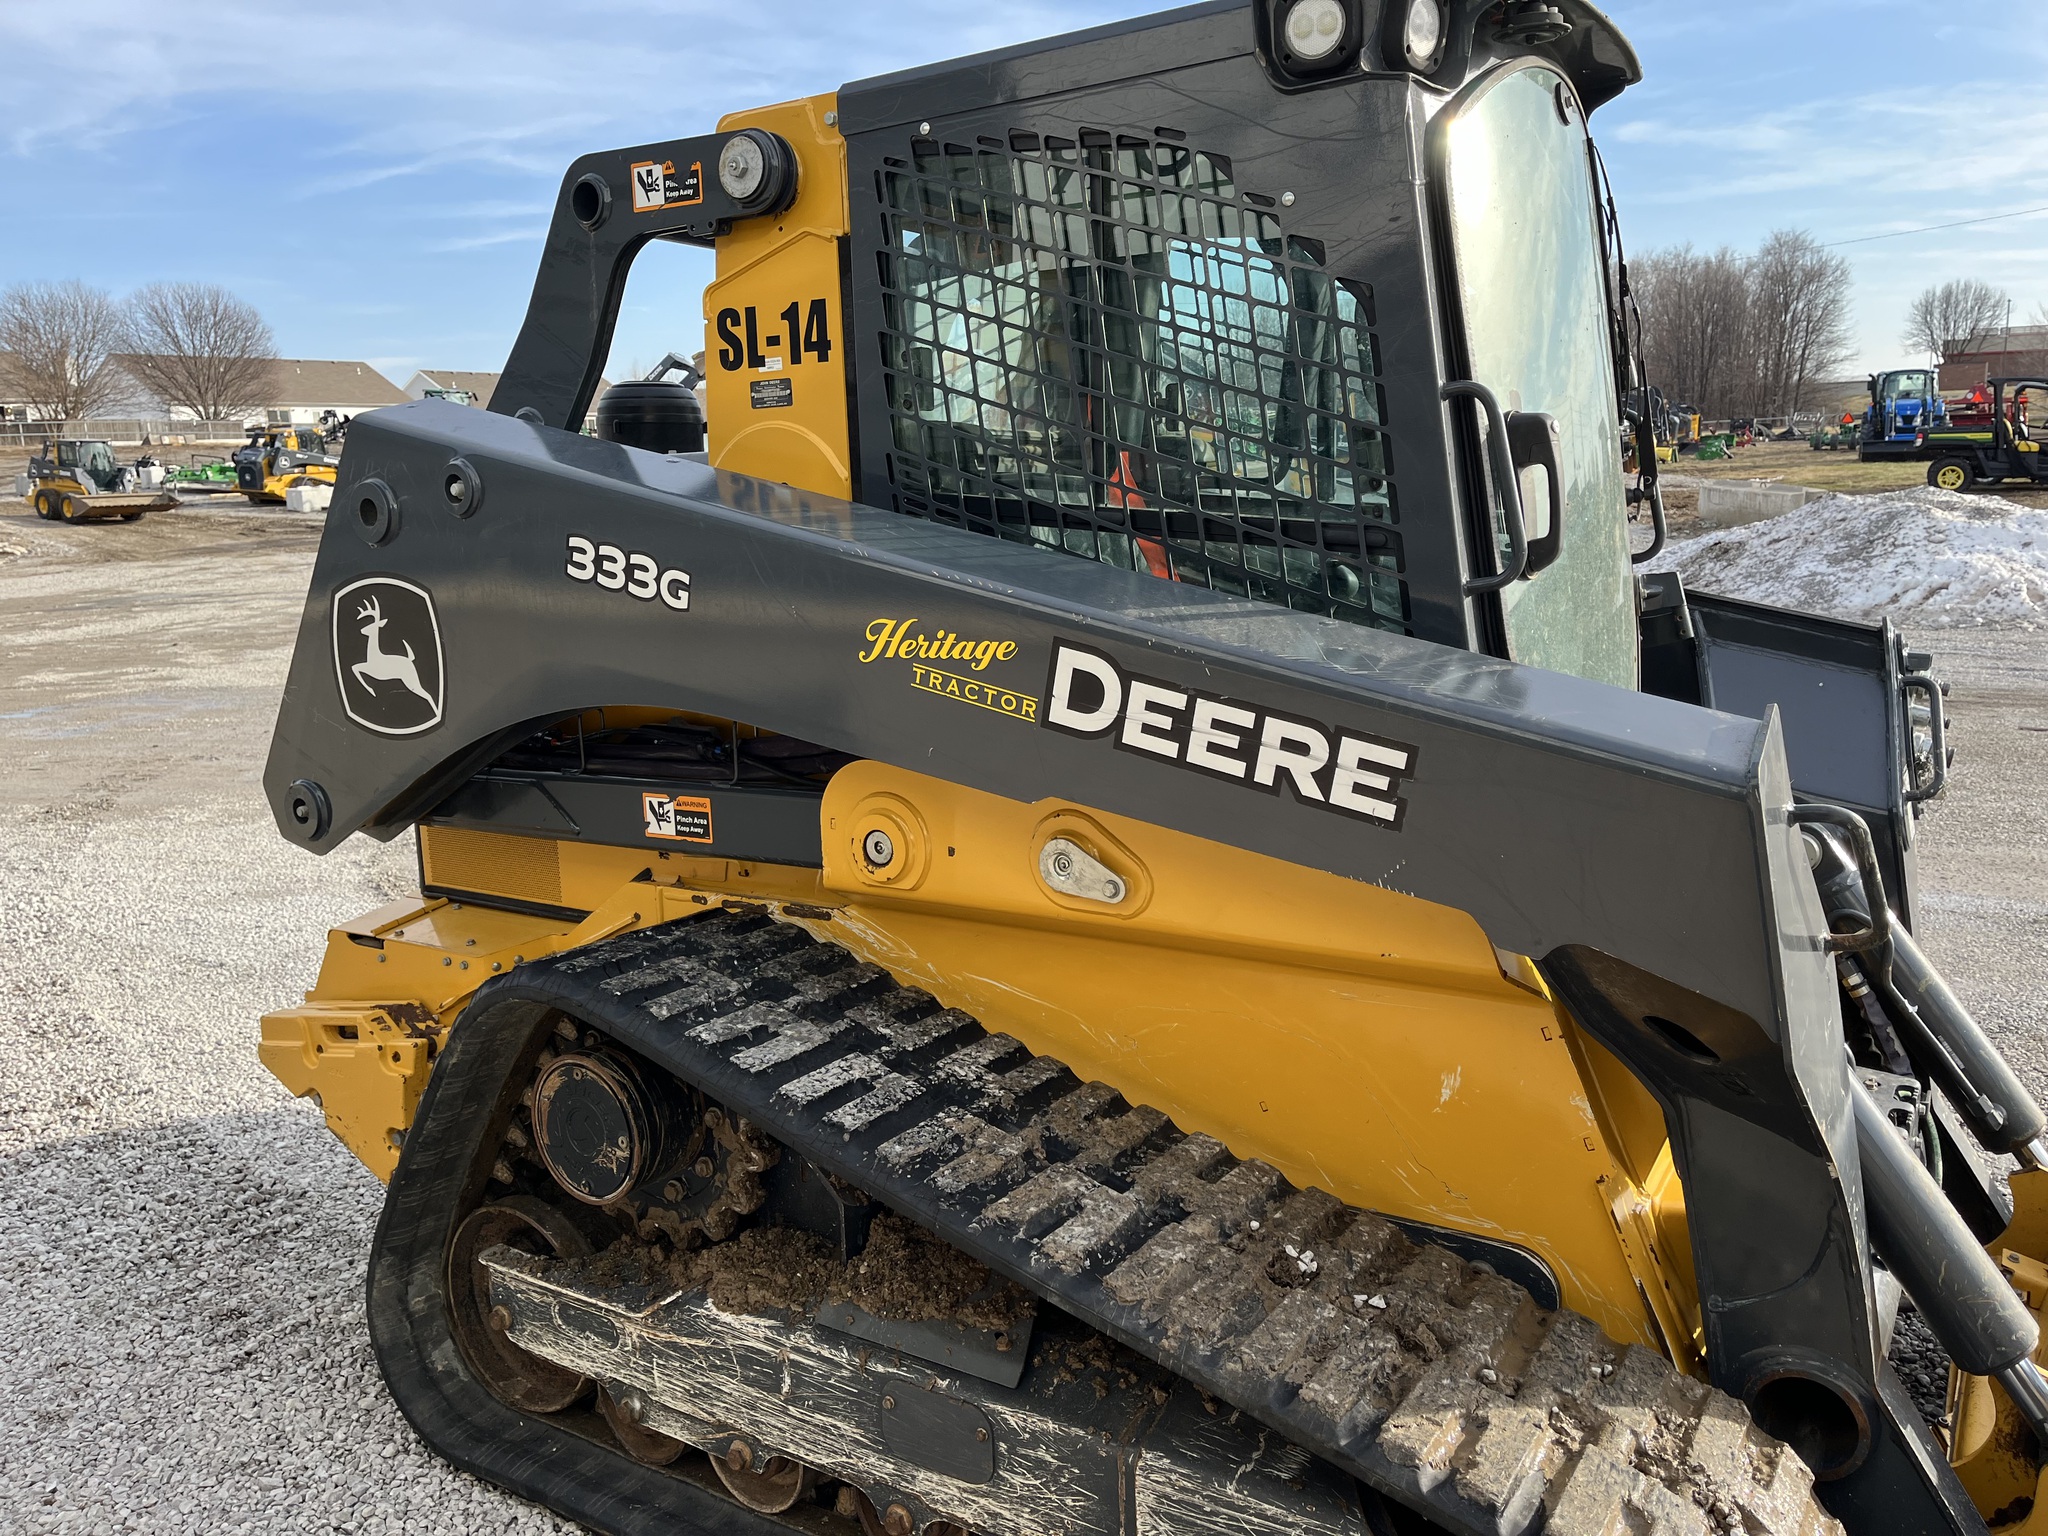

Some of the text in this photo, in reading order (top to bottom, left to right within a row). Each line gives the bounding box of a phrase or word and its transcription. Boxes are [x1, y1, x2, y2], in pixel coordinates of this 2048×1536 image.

[666, 188, 694, 198] Keep Away
[717, 298, 832, 372] SL-14
[566, 535, 691, 610] 333G
[858, 618, 1019, 671] Heritage
[912, 666, 1037, 718] TRACTOR
[1048, 645, 1409, 822] DEERE
[676, 815, 708, 825] Pinch Area
[676, 825, 704, 834] Keep Away
[681, 800, 708, 809] WARNING
